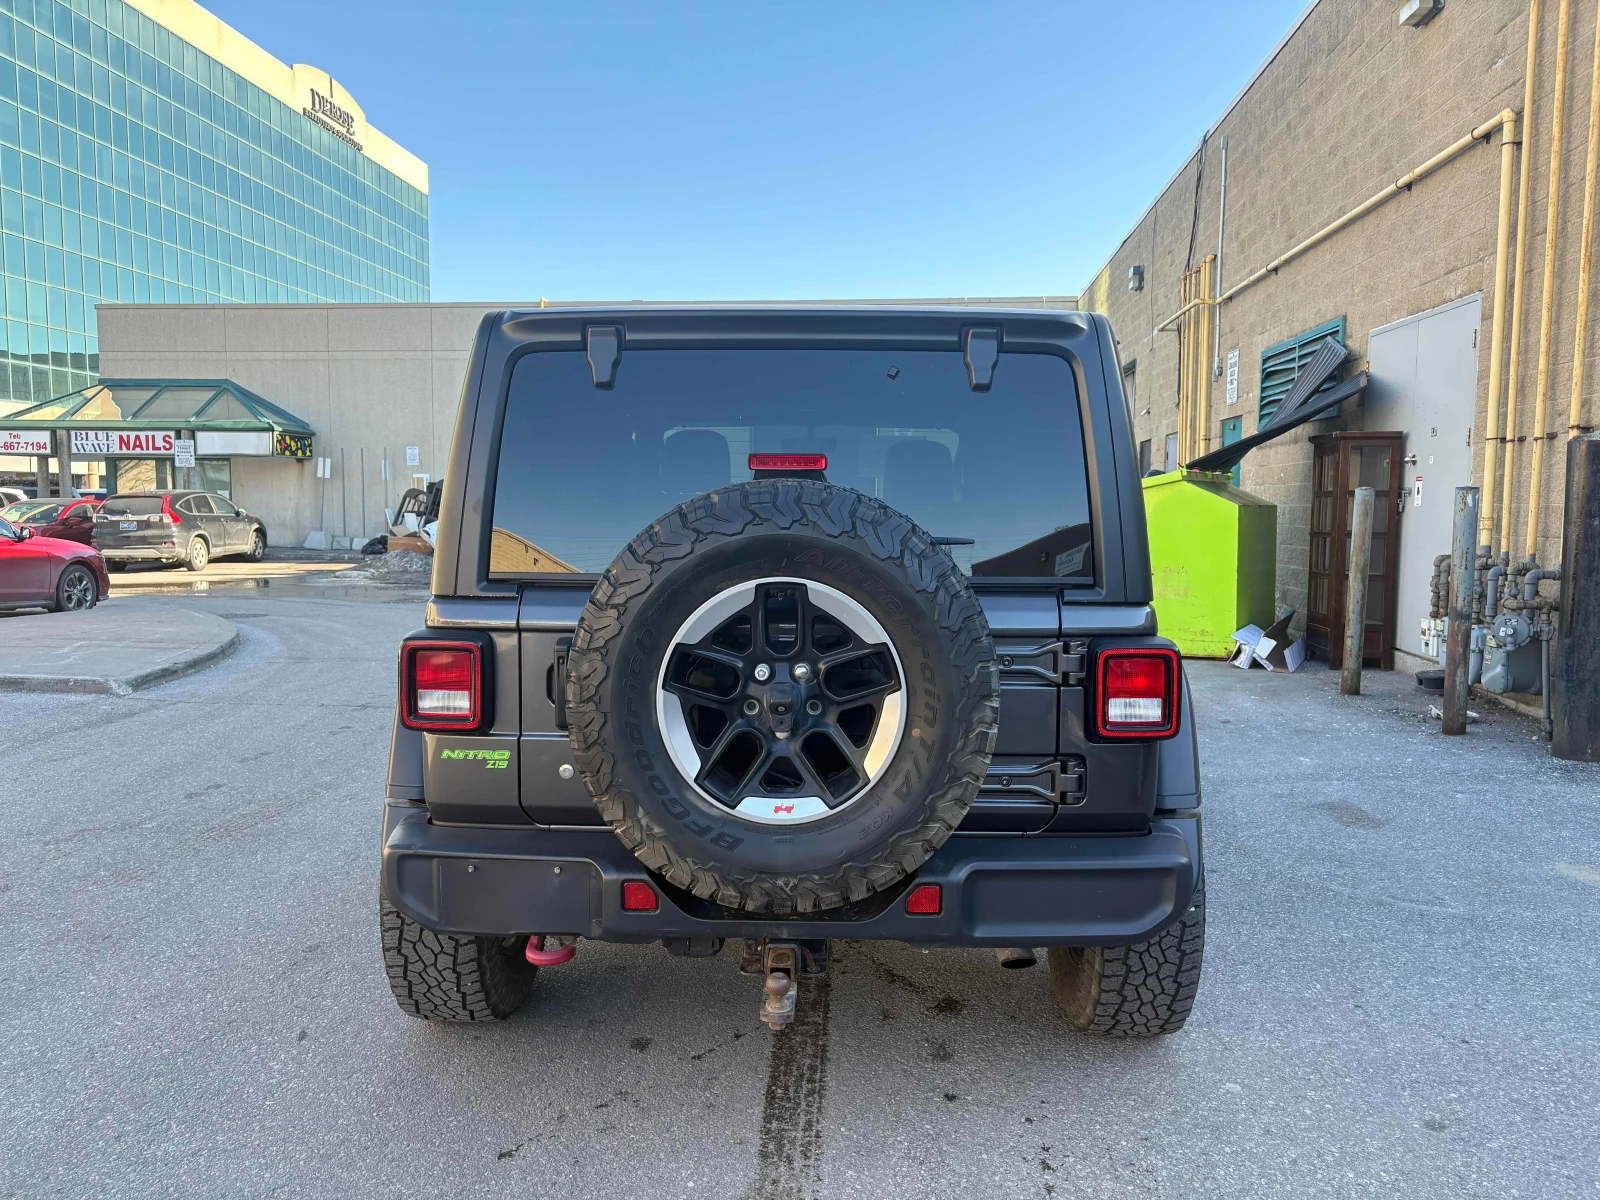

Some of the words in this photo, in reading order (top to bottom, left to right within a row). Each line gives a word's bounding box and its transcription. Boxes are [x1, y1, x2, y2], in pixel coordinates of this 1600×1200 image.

[74, 431, 115, 442] BLUE
[118, 434, 173, 452] NAILS
[74, 442, 115, 453] WAVE
[793, 548, 941, 729] All-Terrain
[892, 737, 937, 804] T/A
[623, 627, 745, 853] BFGoodrich
[440, 748, 512, 760] NITRO
